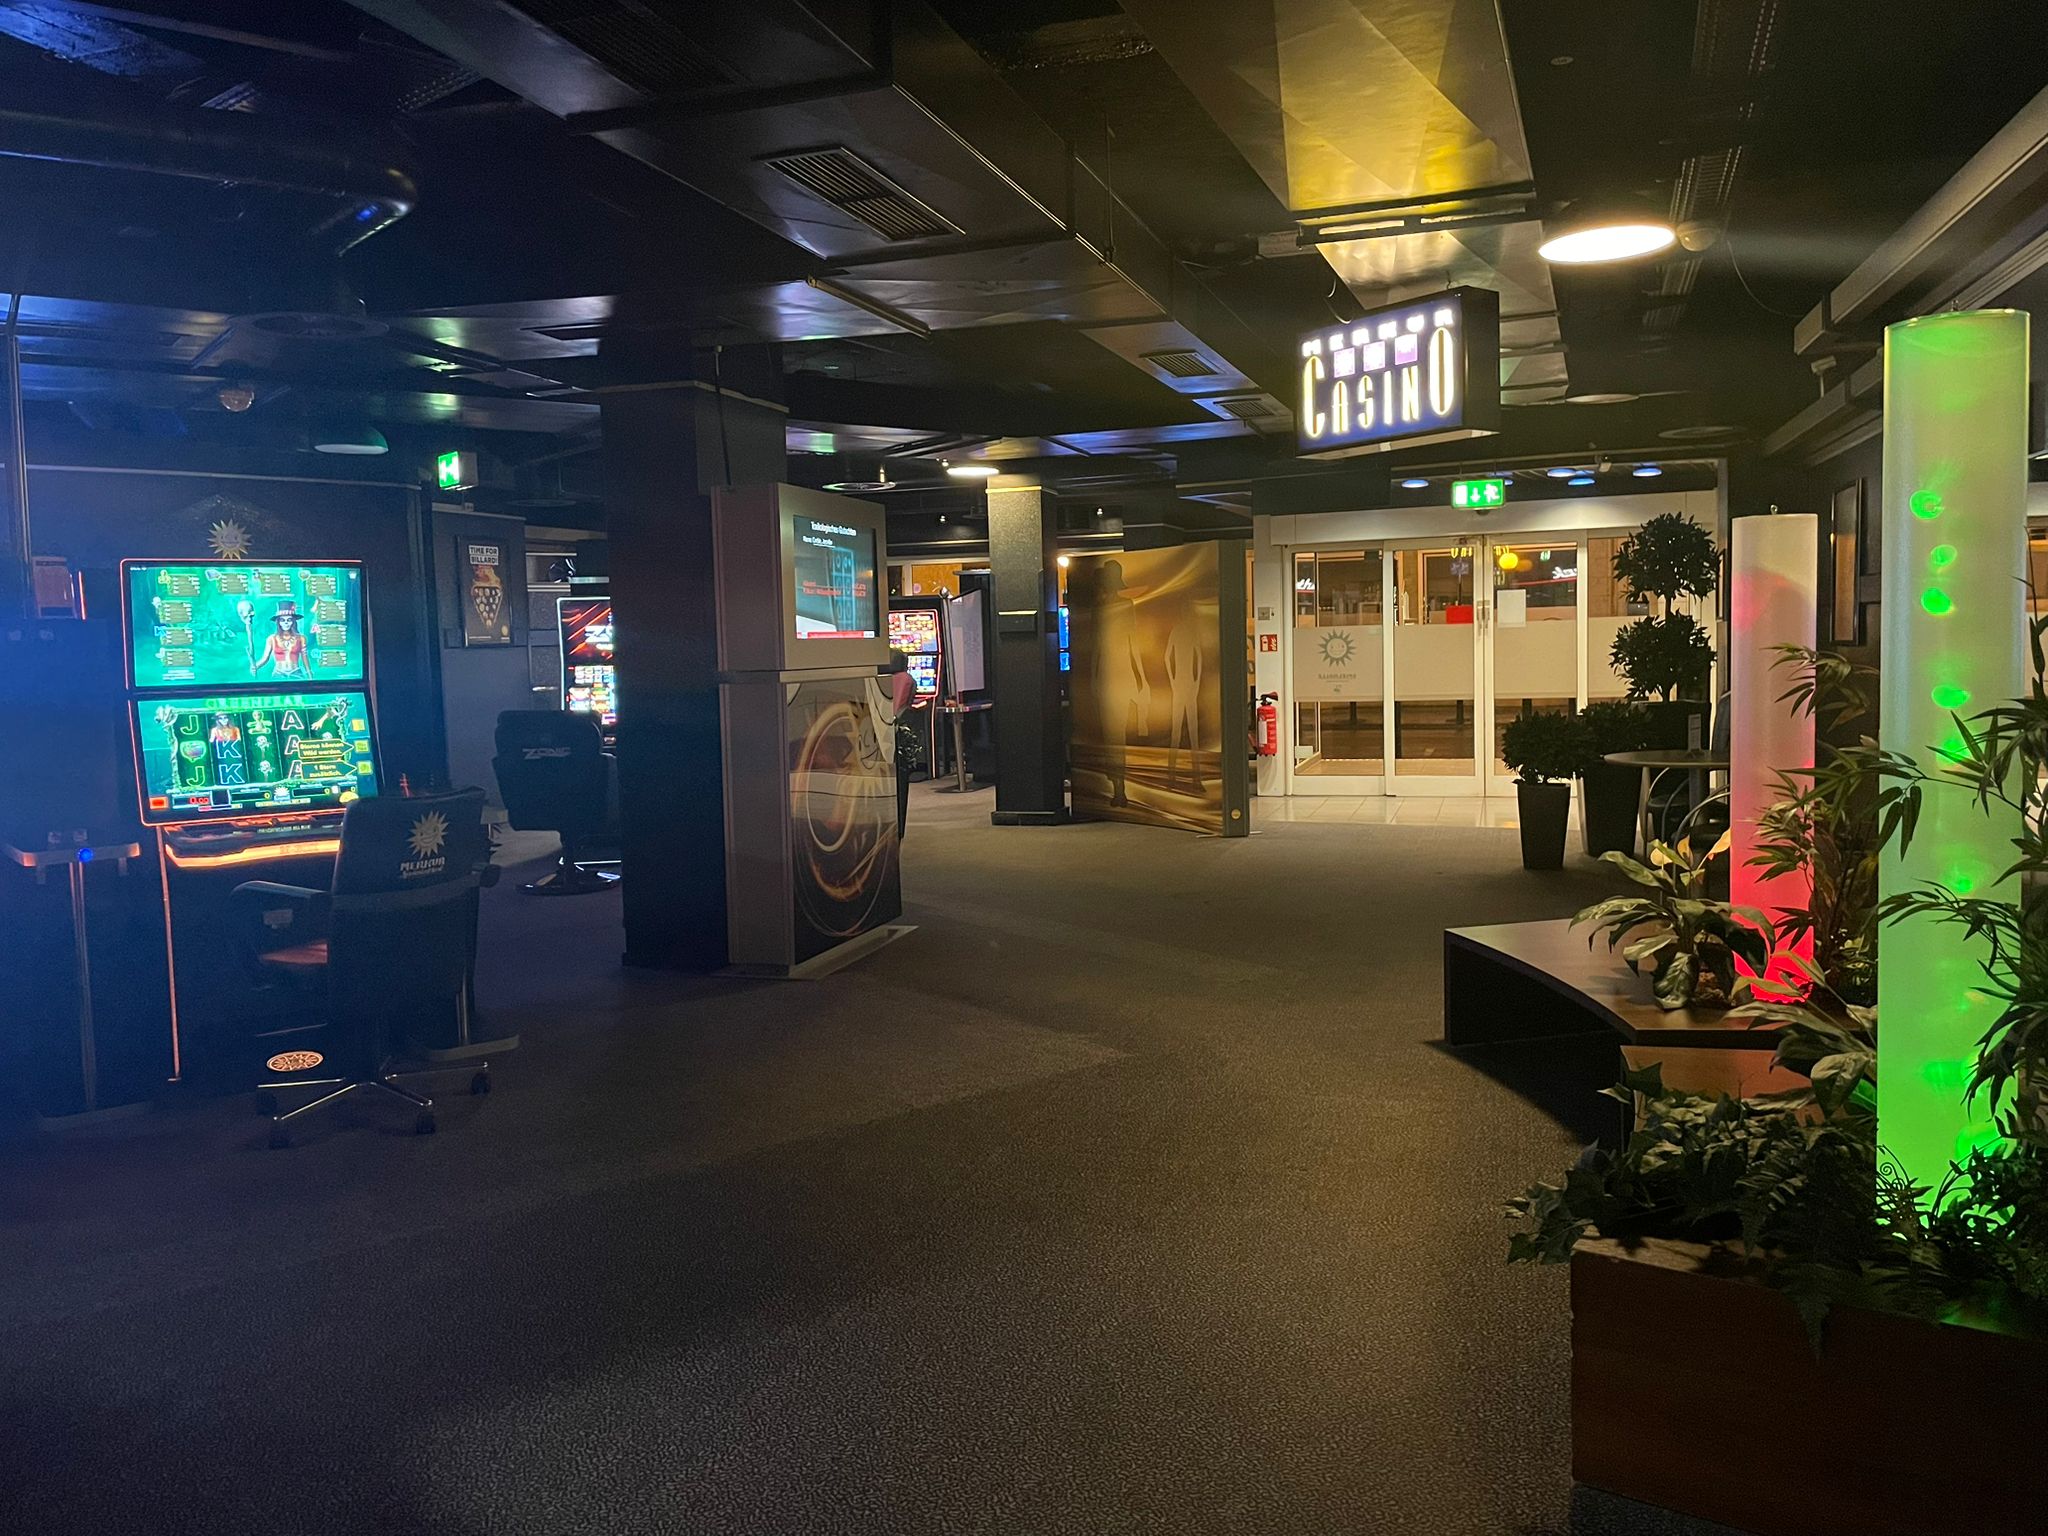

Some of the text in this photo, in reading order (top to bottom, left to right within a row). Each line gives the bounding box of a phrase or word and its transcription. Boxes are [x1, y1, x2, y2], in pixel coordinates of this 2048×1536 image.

[1302, 309, 1454, 357] MERKUR
[1302, 327, 1455, 438] CASINO
[469, 547, 498, 555] TIME FOR
[471, 556, 498, 564] BILLARD!
